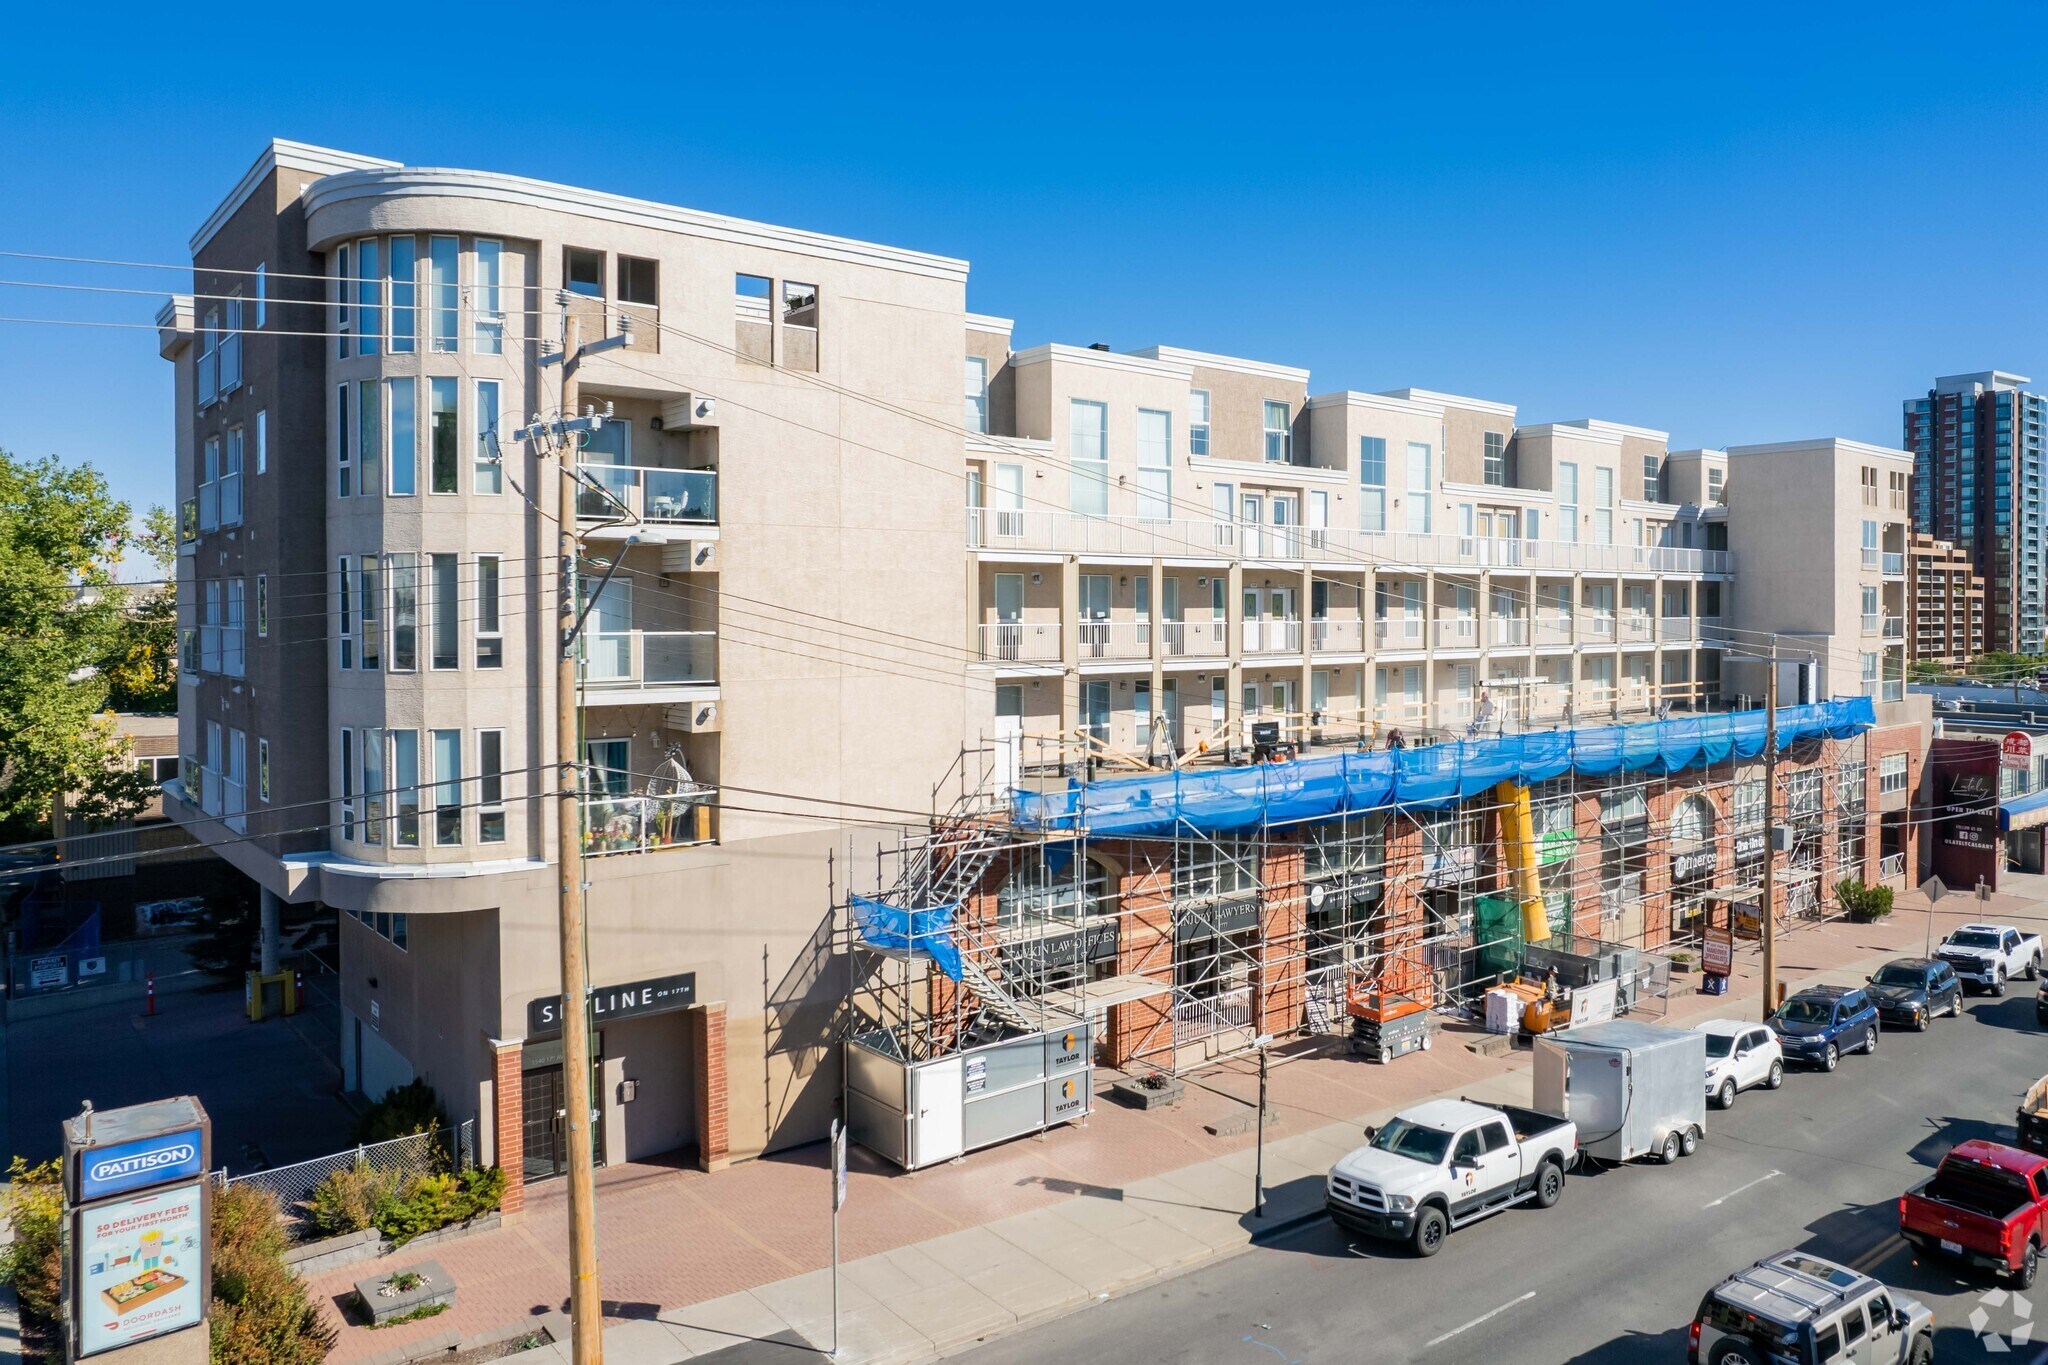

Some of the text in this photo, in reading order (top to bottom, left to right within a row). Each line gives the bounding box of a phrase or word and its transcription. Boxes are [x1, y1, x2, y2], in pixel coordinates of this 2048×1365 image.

[1950, 773, 1990, 799] Lately
[1944, 838, 1994, 850] @LATELYCALGARY
[1180, 912, 1212, 927] INJURY
[1215, 903, 1256, 920] LAWYERS
[1051, 940, 1073, 953] LAW
[1074, 931, 1115, 949] OFICES
[542, 987, 690, 1023] SLINE ON 17TH
[1056, 1053, 1080, 1065] TAYLOR
[1055, 1100, 1080, 1112] TAYLOR
[99, 1148, 187, 1177] PATTISON
[1461, 1188, 1477, 1198] TAYLOR
[96, 1231, 113, 1239] FOR
[115, 1226, 136, 1234] YOUR
[138, 1220, 158, 1229] FIRST
[97, 1204, 190, 1233] $0 DELIVERY FEES
[123, 1304, 182, 1327] DOORDASH
